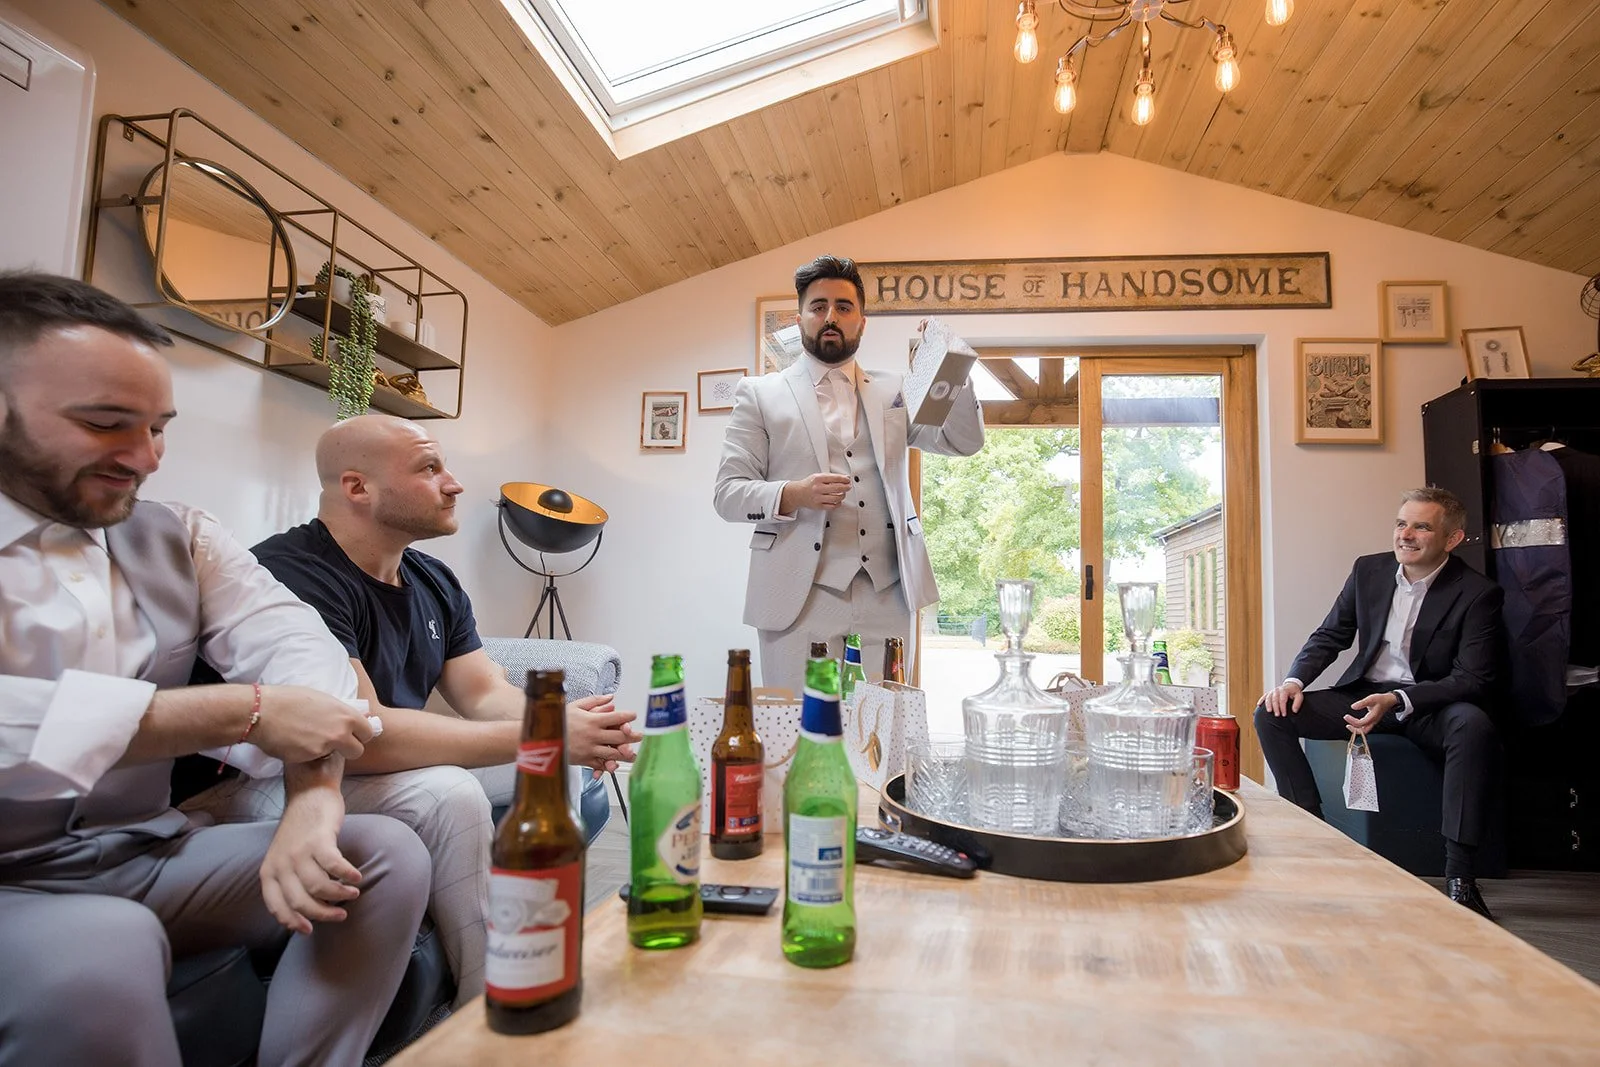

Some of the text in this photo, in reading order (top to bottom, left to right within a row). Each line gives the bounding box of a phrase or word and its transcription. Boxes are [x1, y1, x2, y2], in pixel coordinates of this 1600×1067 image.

[876, 267, 1302, 302] HOUSE OF HANDSOME
